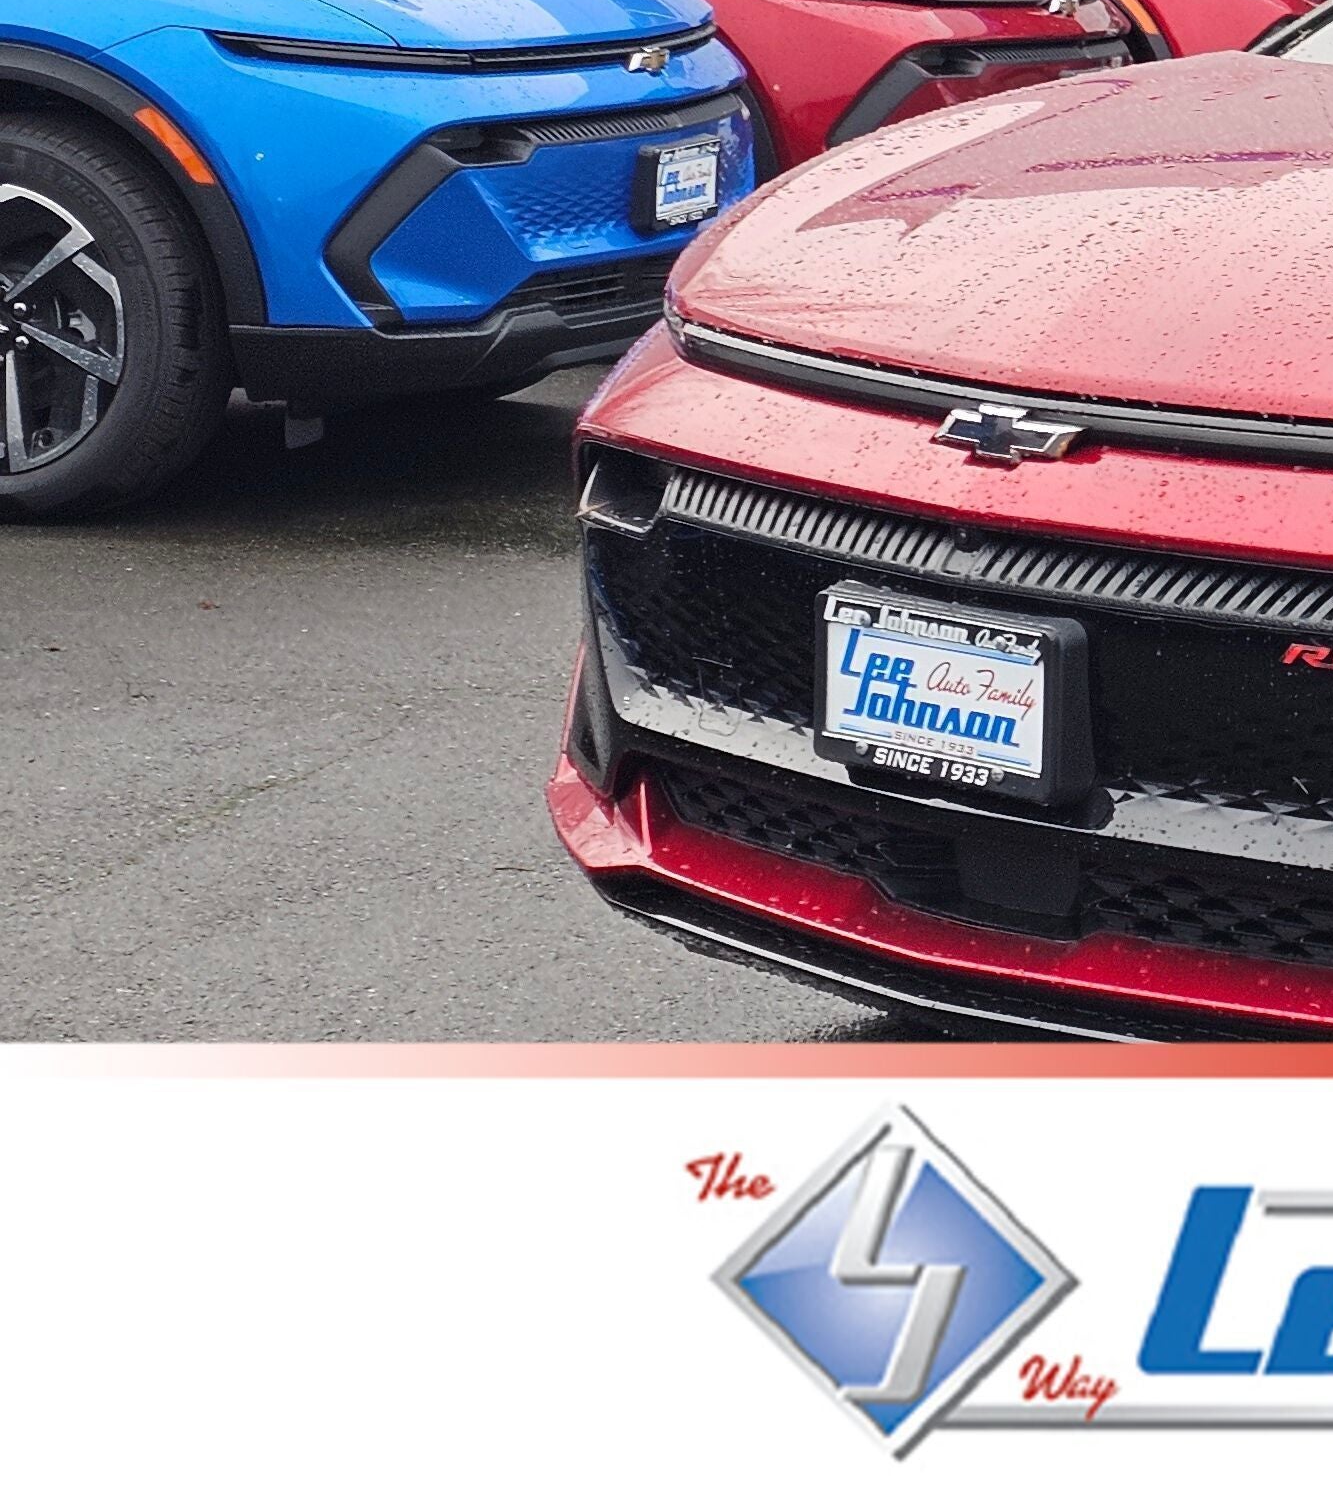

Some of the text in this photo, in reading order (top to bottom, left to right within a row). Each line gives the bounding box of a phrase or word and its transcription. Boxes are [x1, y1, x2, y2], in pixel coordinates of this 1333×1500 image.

[840, 627, 1037, 722] Lee Auto Family
[842, 674, 1021, 749] Johnson
[872, 746, 990, 788] SINCE 1933
[893, 729, 976, 756] SINCE 1933
